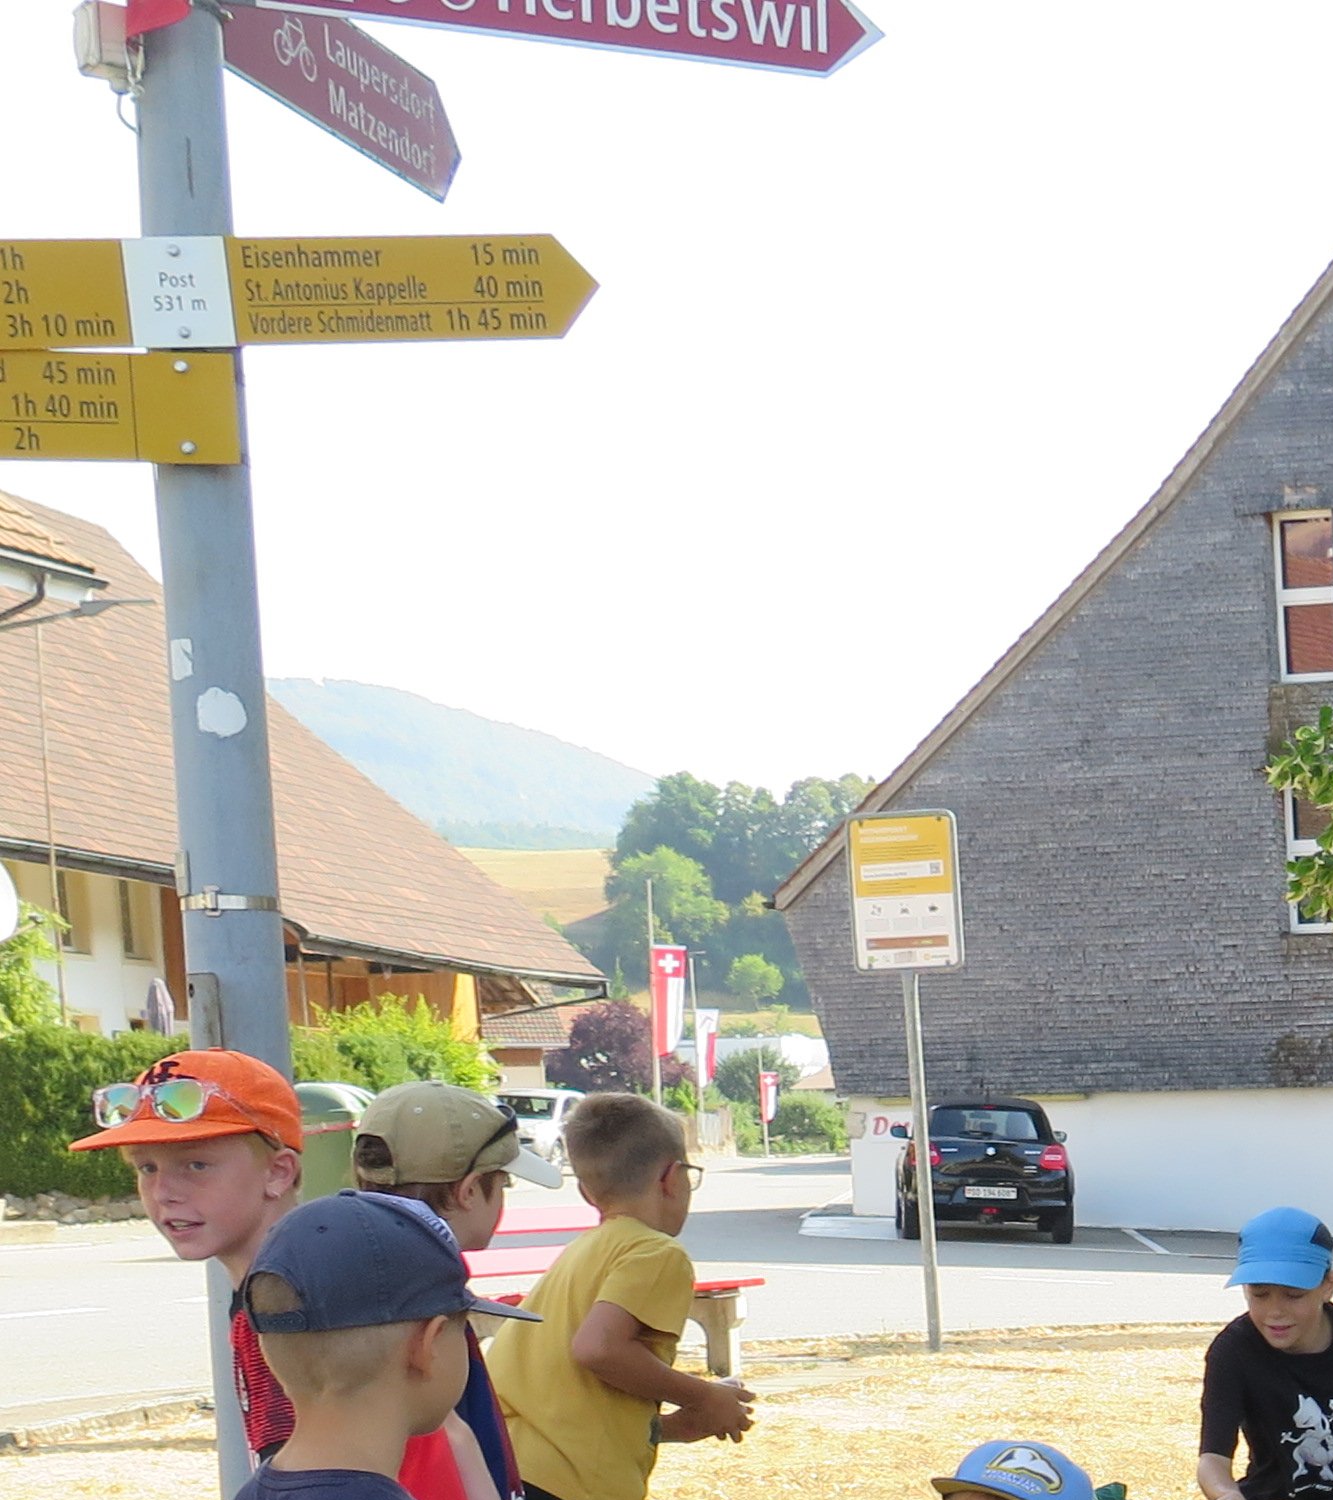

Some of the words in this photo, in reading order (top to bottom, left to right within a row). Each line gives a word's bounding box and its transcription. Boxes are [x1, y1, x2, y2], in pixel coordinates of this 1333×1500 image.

[323, 22, 436, 131] Laupersdorf
[328, 78, 437, 179] Matzendorf
[0, 246, 25, 271] 1h
[241, 244, 382, 269] Eisenhammer
[470, 243, 495, 266] 15
[502, 241, 540, 265] min
[3, 280, 29, 304] 2h
[158, 271, 196, 289] Post
[245, 278, 269, 302] St.
[272, 277, 348, 302] Antonius
[353, 275, 428, 306] Kappelle
[473, 275, 499, 299] 40
[506, 274, 544, 298] min
[153, 295, 184, 312] 531
[191, 299, 208, 312] m
[8, 315, 33, 338] 3h
[42, 314, 67, 337] 10
[75, 313, 116, 338] min
[248, 310, 313, 335] Vordere
[319, 308, 433, 334] Schmidenmatt
[446, 308, 470, 331] 1h
[477, 307, 502, 331] 45
[510, 306, 547, 331] min
[42, 361, 68, 384] 45
[77, 361, 117, 385] min
[12, 394, 38, 418] 1h
[45, 394, 71, 418] 40
[79, 395, 119, 419] min
[15, 427, 41, 451] 2h
